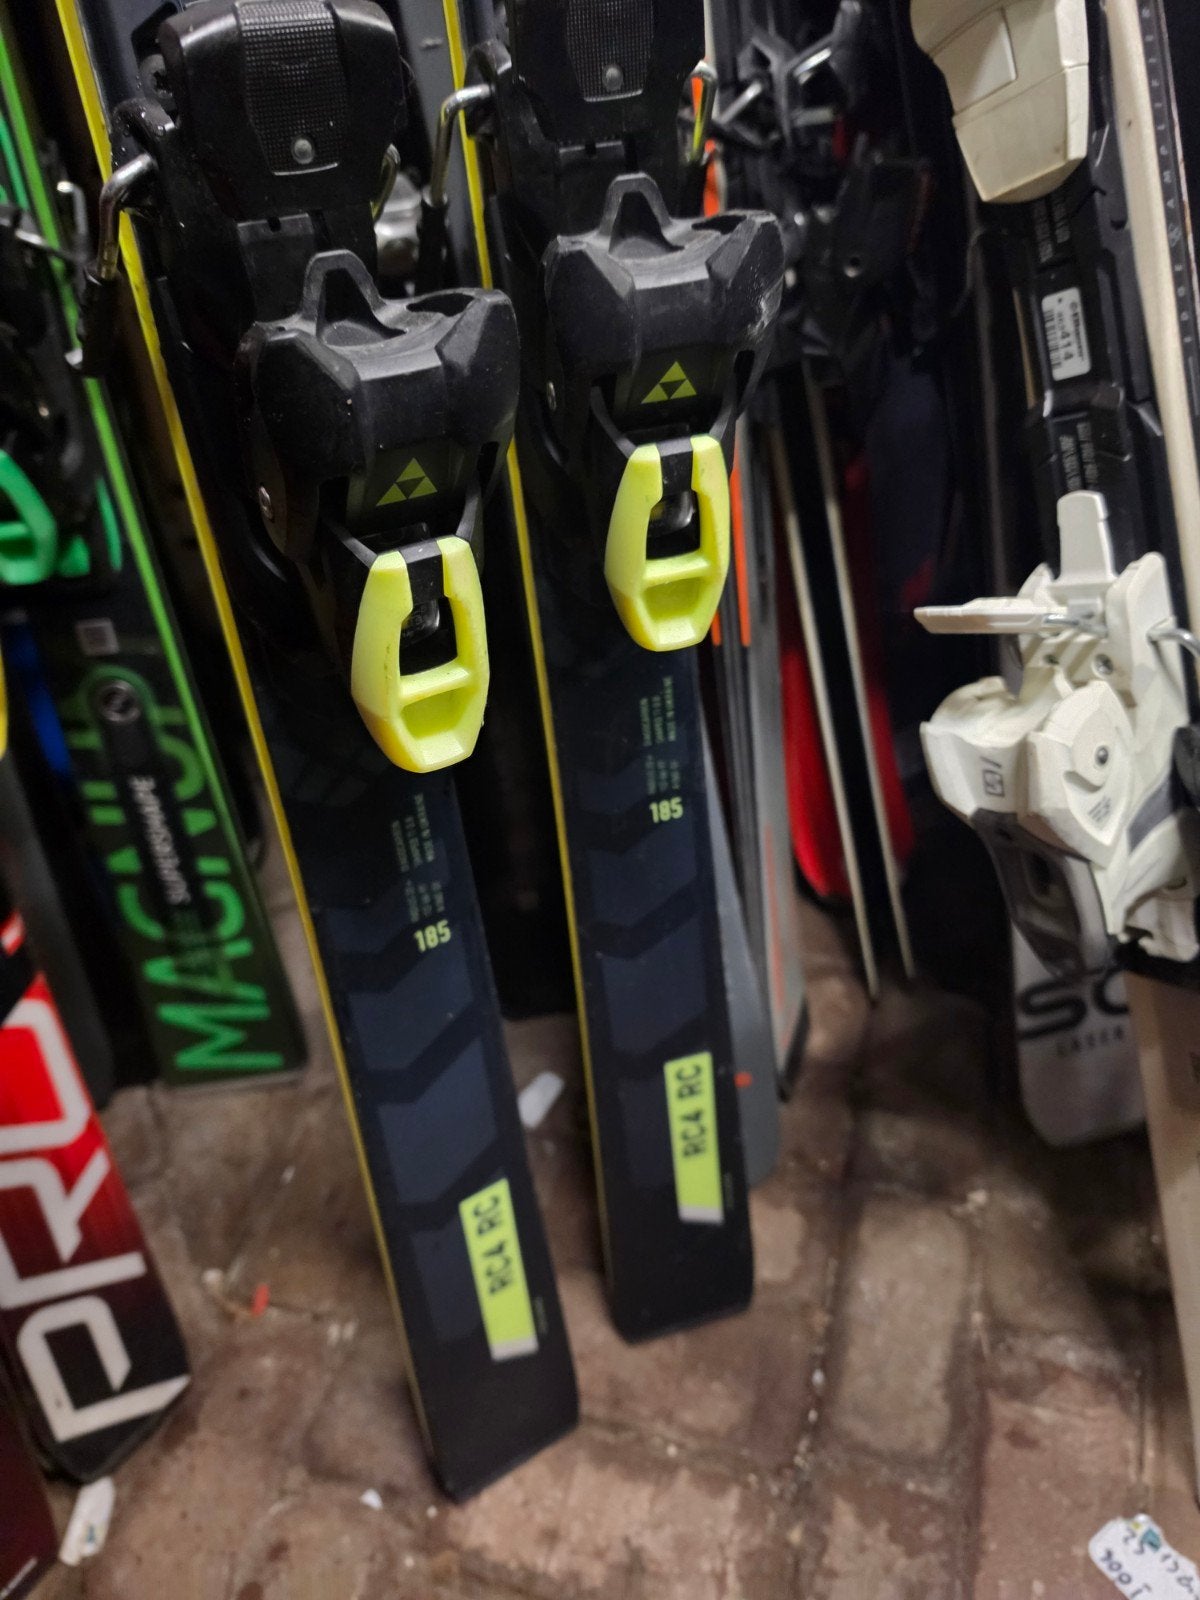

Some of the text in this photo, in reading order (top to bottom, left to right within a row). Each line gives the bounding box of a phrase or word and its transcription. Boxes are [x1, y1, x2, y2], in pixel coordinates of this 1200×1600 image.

[128, 774, 192, 904] SUPERSHAPE
[649, 796, 684, 823] 185
[413, 919, 452, 952] 185
[674, 1064, 708, 1159] RC4 RC
[472, 1195, 513, 1296] RC4 RC
